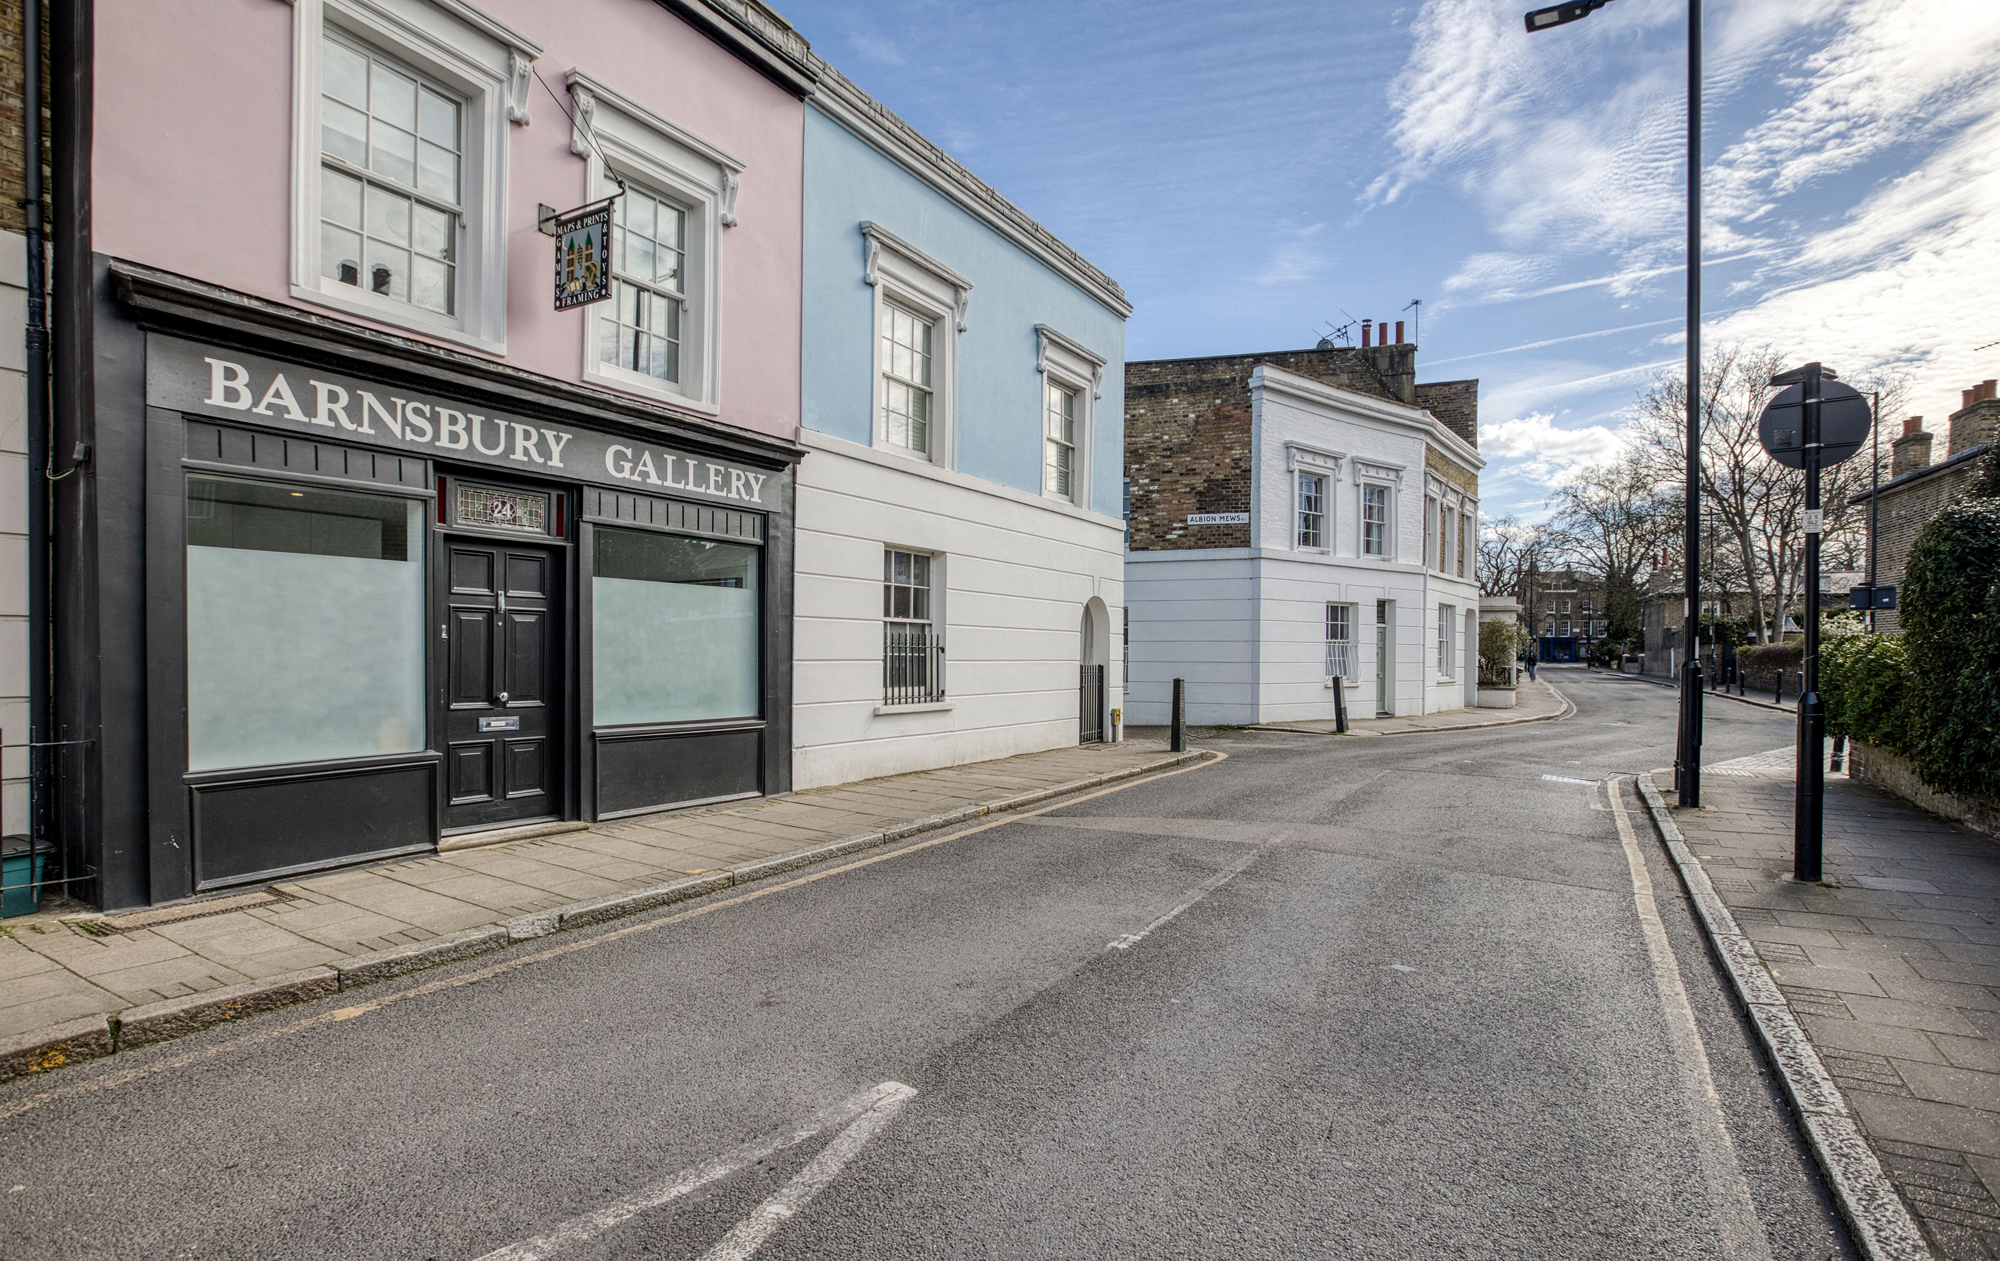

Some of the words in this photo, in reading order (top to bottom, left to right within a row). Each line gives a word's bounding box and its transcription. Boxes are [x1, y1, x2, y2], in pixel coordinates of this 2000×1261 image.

[557, 222, 575, 235] MAPS
[576, 219, 582, 230] &
[583, 211, 608, 228] PRINTS
[602, 223, 608, 233] &
[562, 289, 599, 306] FRAMING
[203, 356, 573, 468] BARNSBURY
[605, 444, 767, 503] GALLERY
[493, 501, 513, 518] 24
